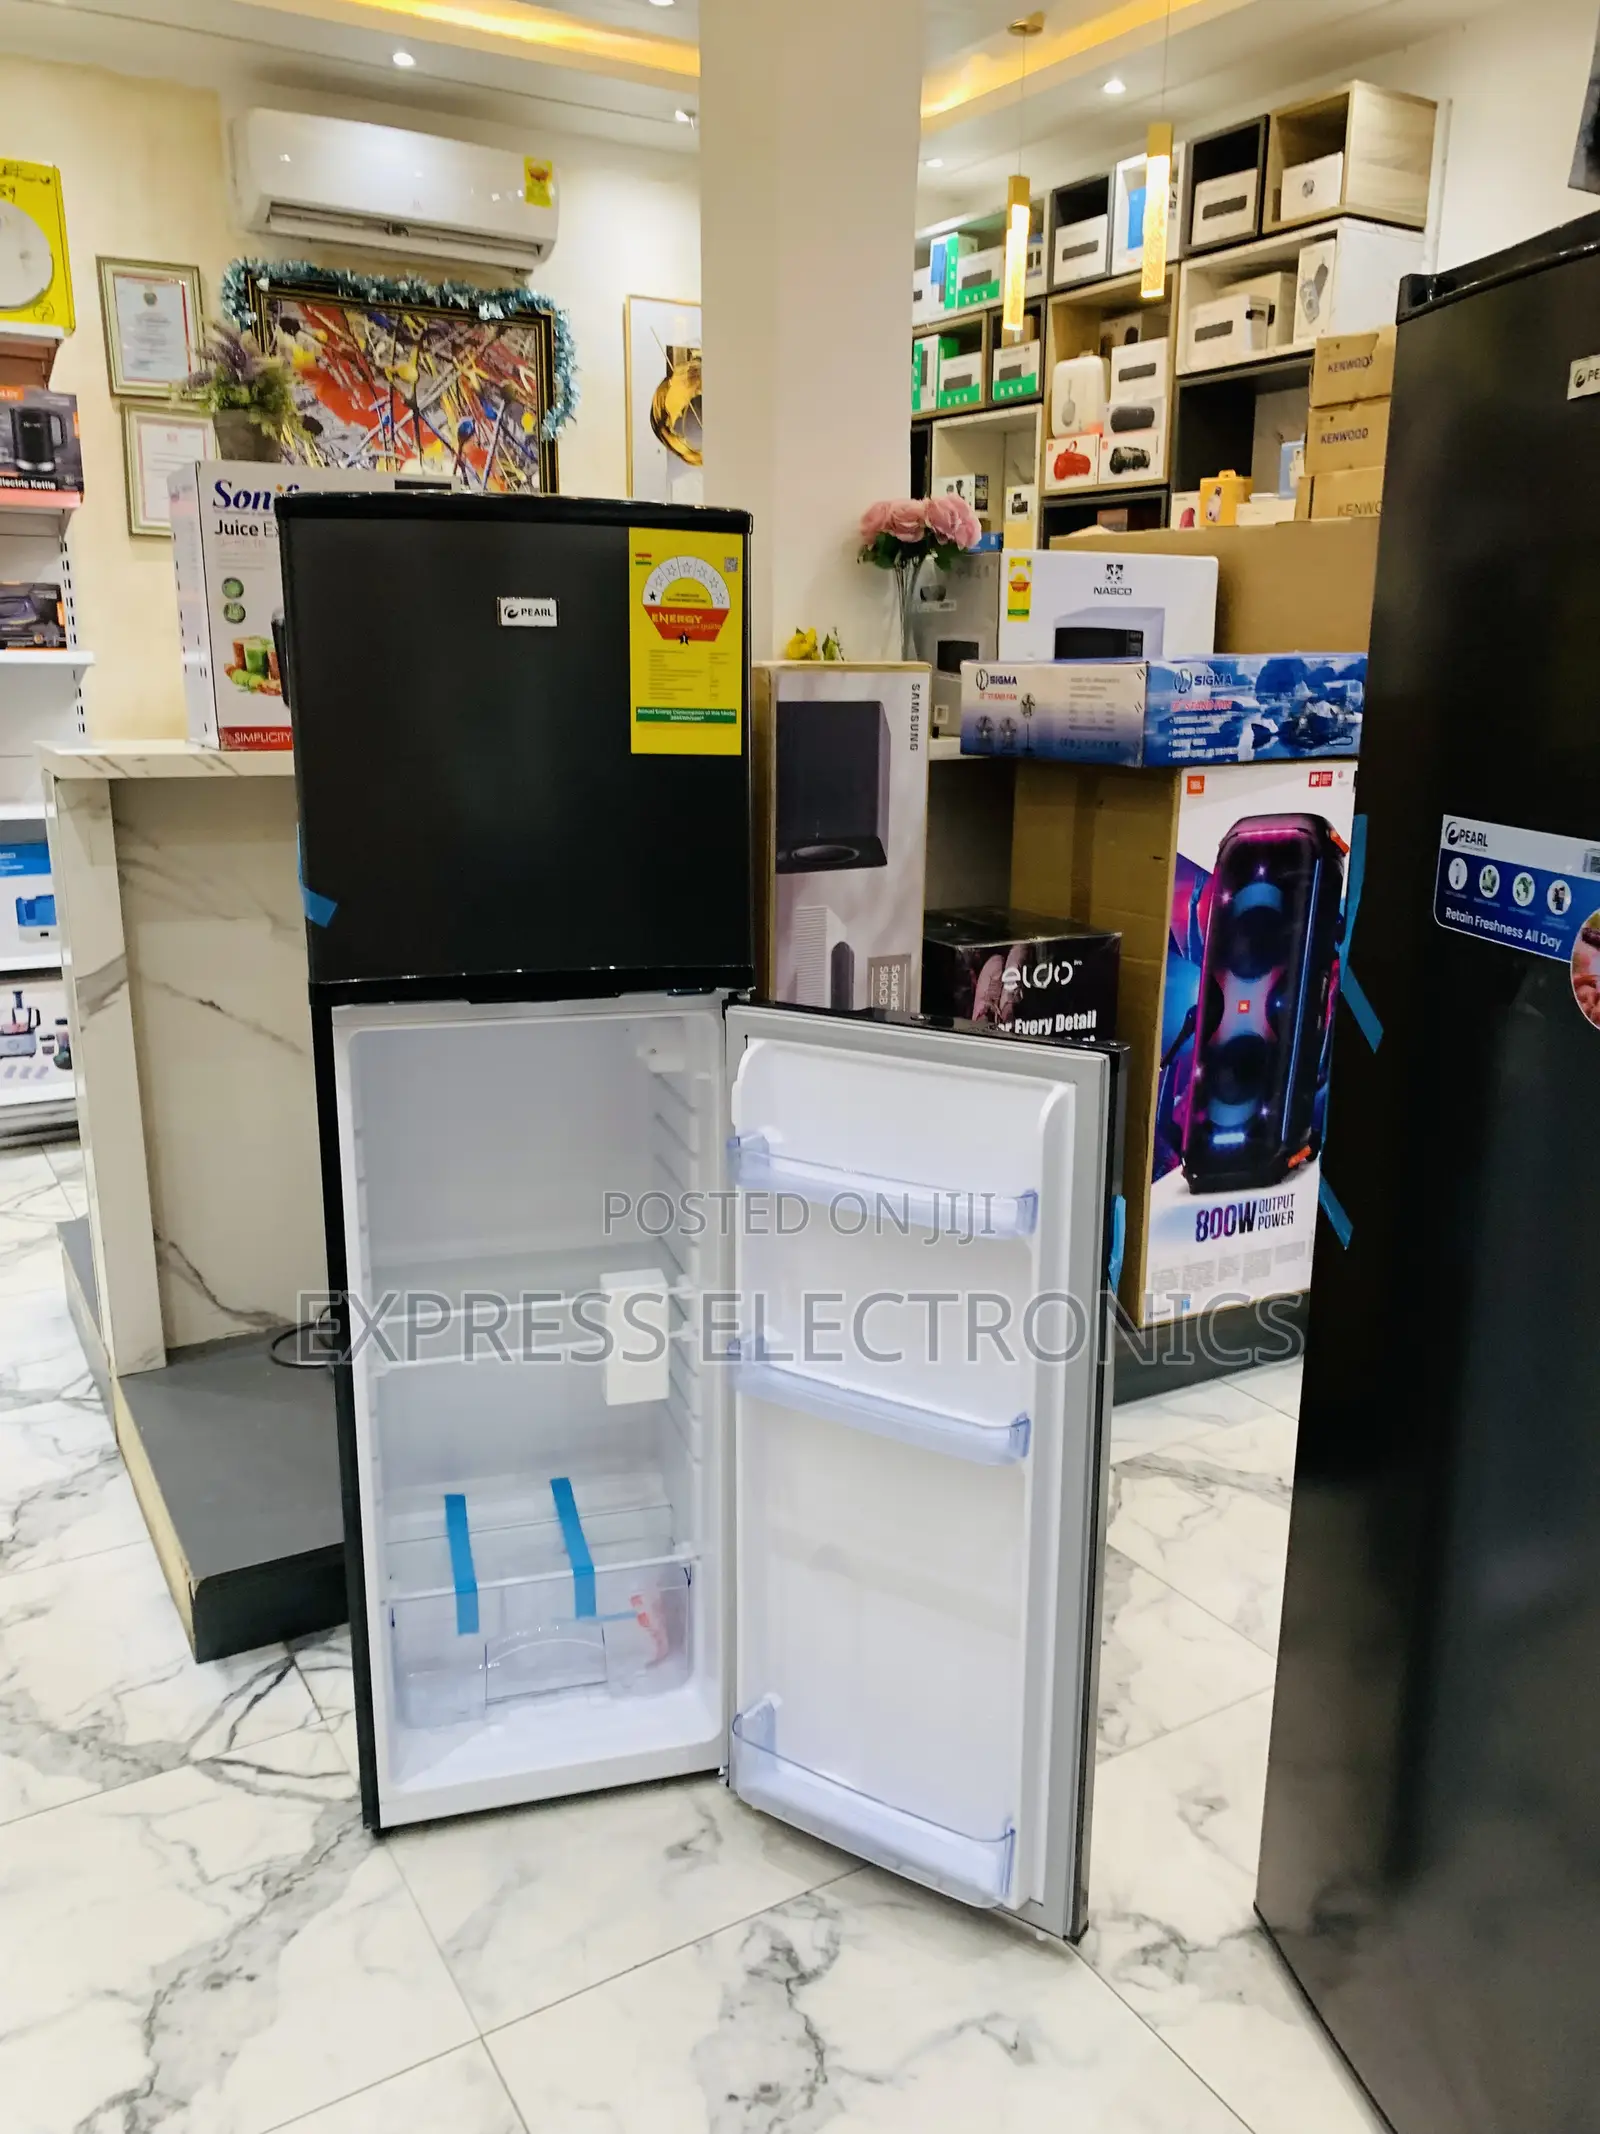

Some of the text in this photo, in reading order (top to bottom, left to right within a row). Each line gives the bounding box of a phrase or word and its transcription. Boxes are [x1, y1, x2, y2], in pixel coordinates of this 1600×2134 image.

[1320, 427, 1369, 445] KENWOOD
[214, 519, 259, 537] Juice
[1093, 587, 1132, 596] NASCO
[521, 608, 554, 617] PEARL
[651, 612, 702, 625] ENERGY
[989, 676, 1017, 685] SIGMA
[1194, 674, 1233, 686] SIGMA
[910, 683, 921, 751] SAMSUNG
[234, 732, 292, 743] SIMPLICITY
[1458, 828, 1489, 847] PEARL
[1446, 907, 1473, 926] Retain
[1475, 915, 1524, 939] Freshness
[1525, 929, 1539, 943] All
[1540, 932, 1562, 952] Day
[1014, 1017, 1053, 1036] Every
[1055, 1009, 1097, 1033] Detail
[1195, 1193, 1296, 1242] 800W OUTPUT
[1257, 1210, 1295, 1231] POWER
